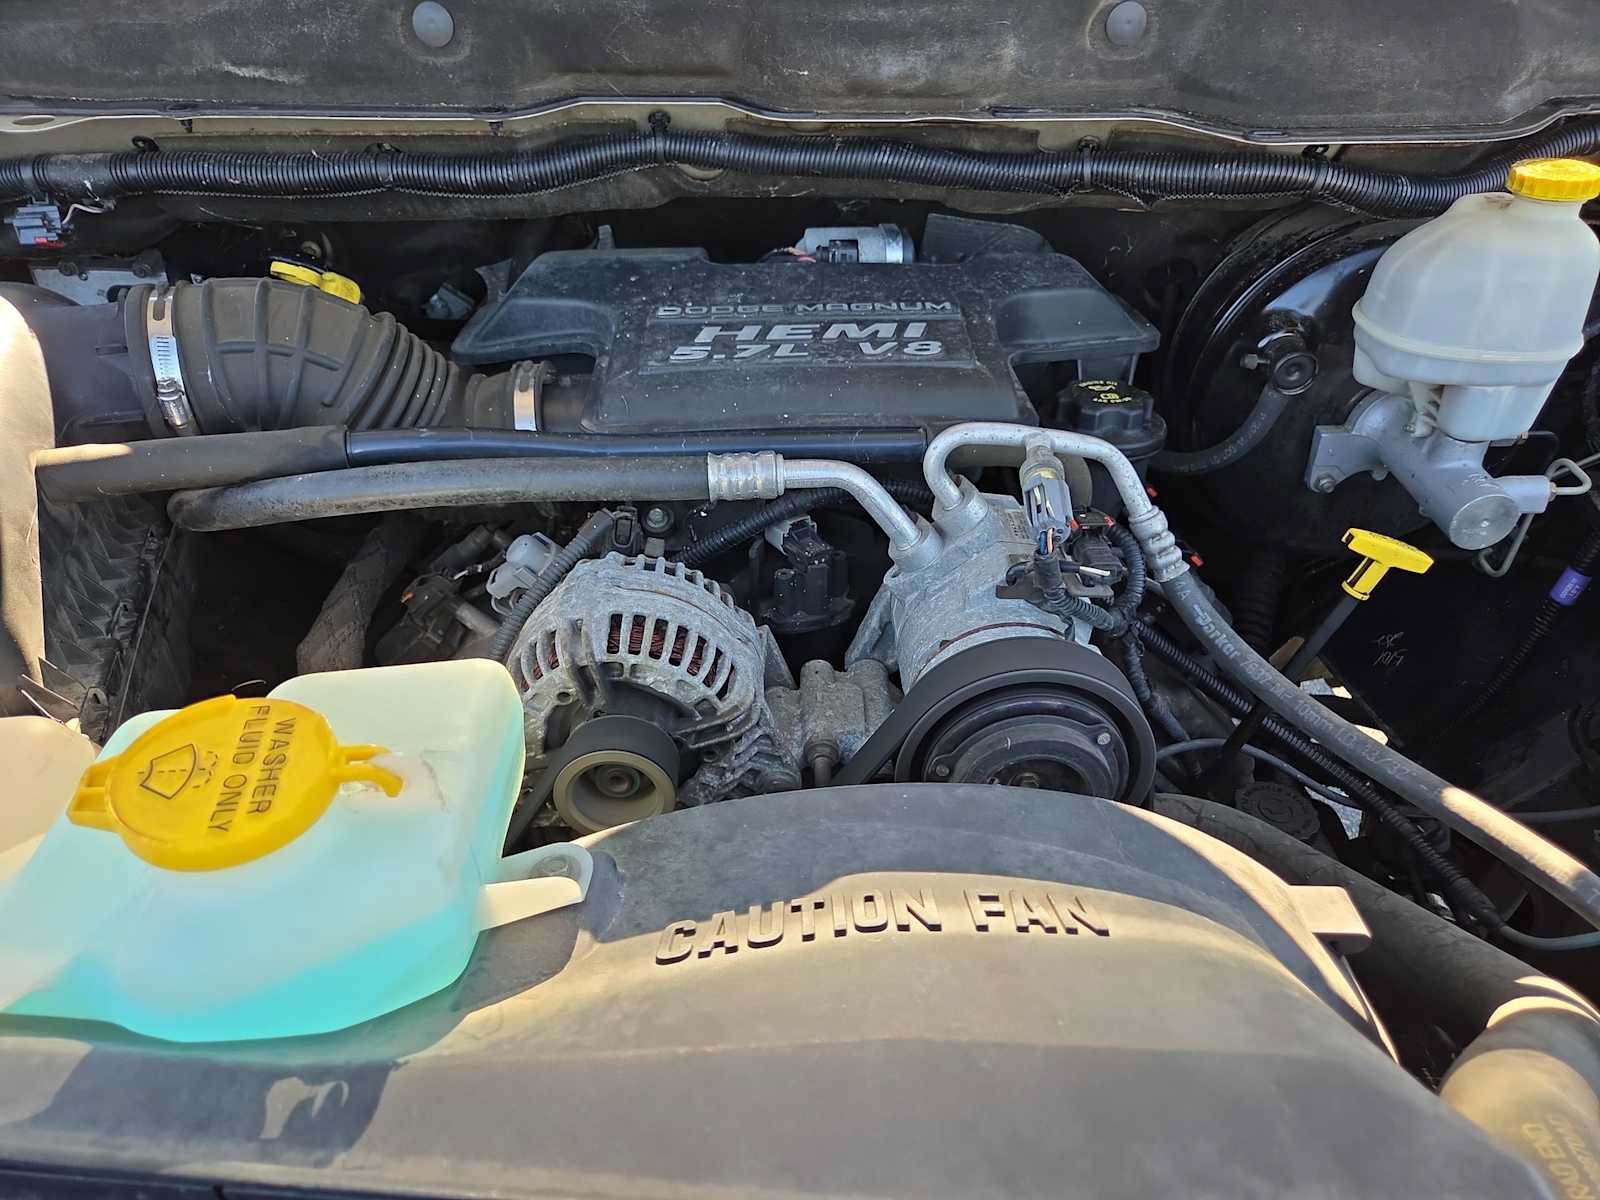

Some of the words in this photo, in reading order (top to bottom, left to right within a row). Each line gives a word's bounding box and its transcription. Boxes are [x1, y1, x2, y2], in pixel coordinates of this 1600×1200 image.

[656, 304, 785, 317] DODGE
[796, 301, 951, 314] MAGNUM
[694, 322, 928, 343] HEMI
[669, 343, 810, 360] 5.7L
[858, 340, 943, 355] V8
[232, 705, 271, 765] FLUID
[246, 717, 297, 814] WASHER
[207, 774, 248, 832] ONLY
[655, 887, 942, 966] CAUTION
[963, 888, 1110, 937] FAN
